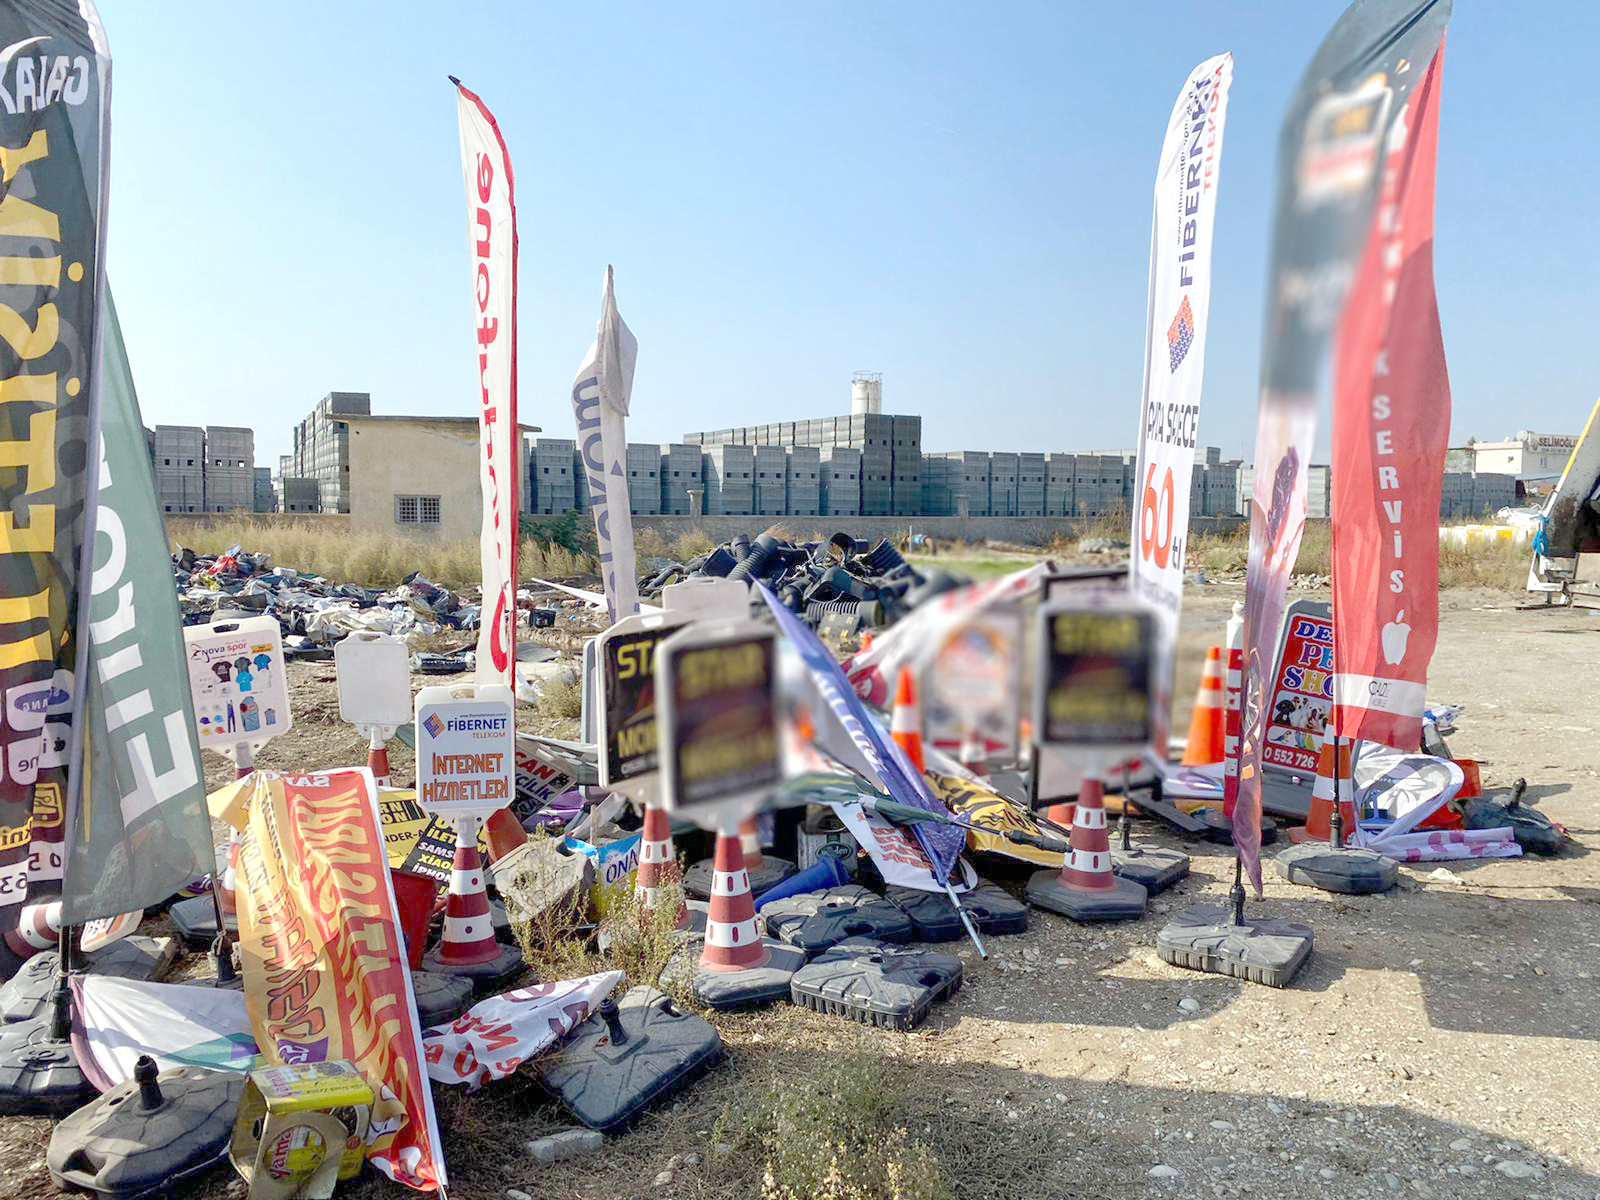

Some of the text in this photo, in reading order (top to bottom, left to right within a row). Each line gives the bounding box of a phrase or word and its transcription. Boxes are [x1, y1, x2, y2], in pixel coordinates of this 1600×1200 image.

[1141, 462, 1175, 570] 60
[226, 641, 248, 656] spor
[447, 717, 507, 731] FİBERNET
[472, 731, 506, 739] TELEKOM
[431, 752, 504, 776] İNTERNET
[423, 776, 509, 803] HİZMETLERİ
